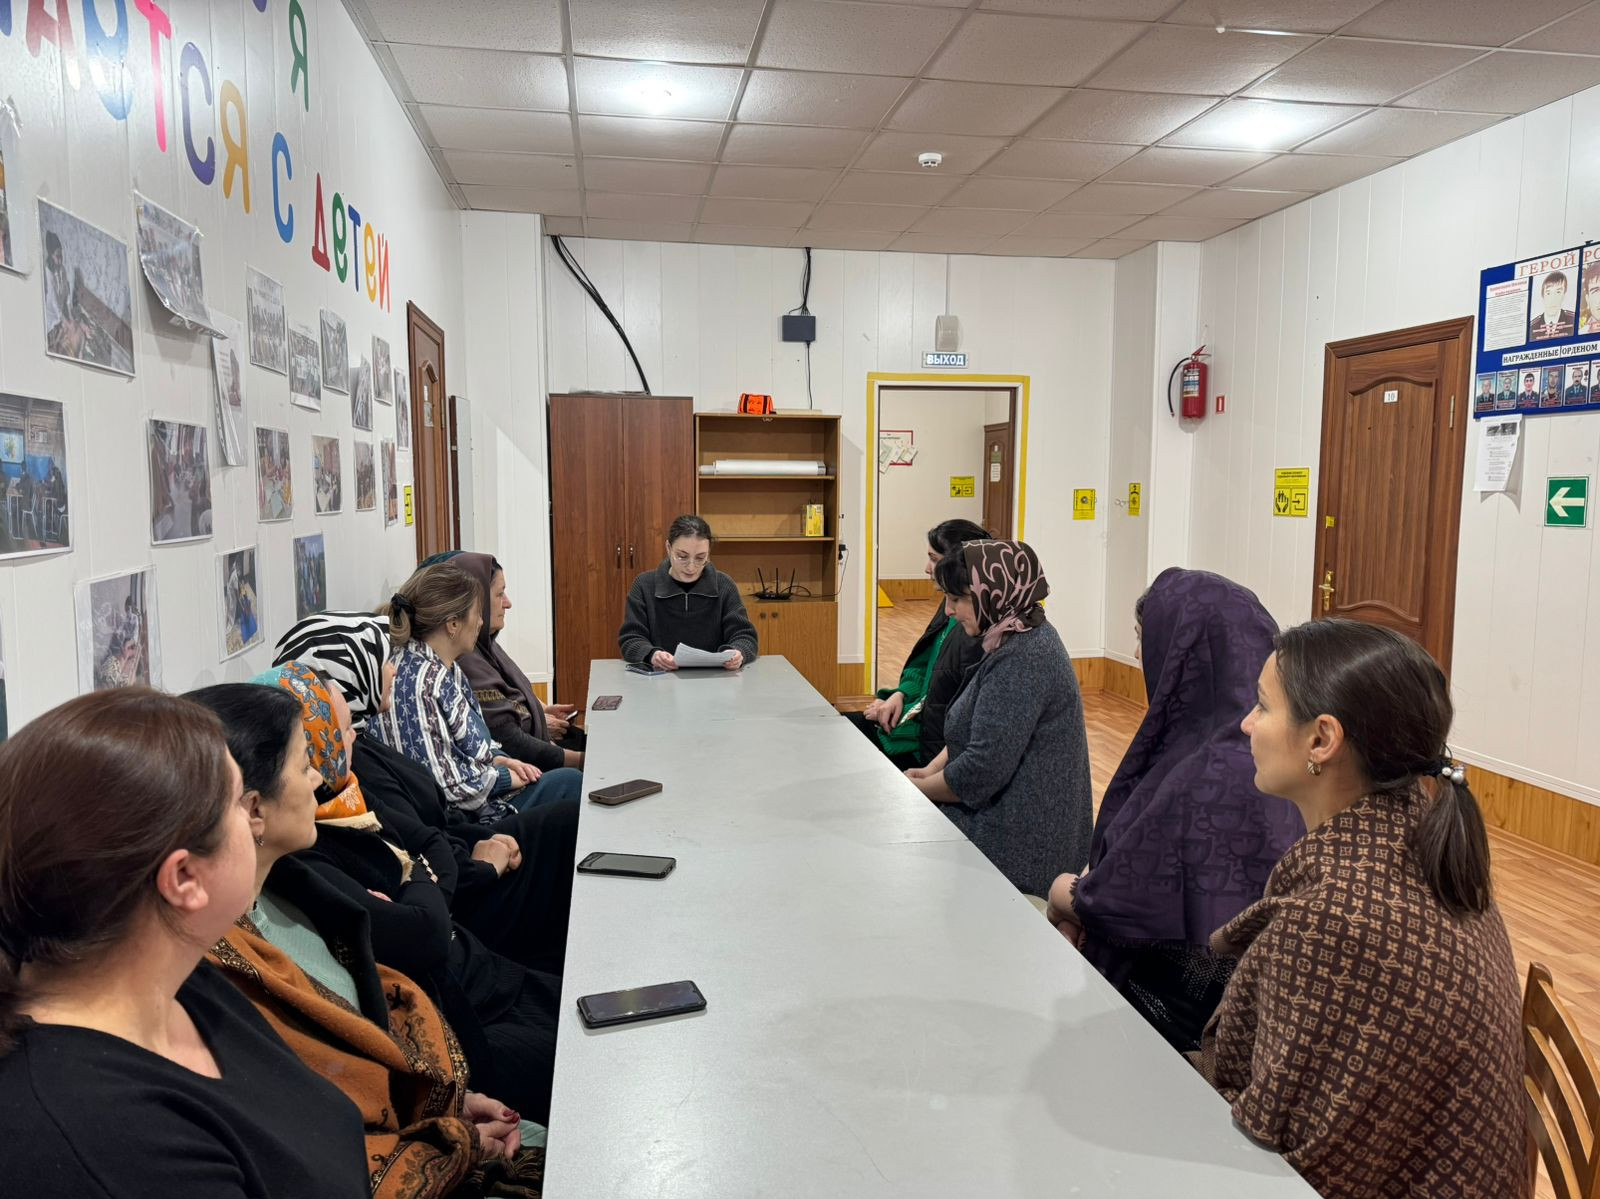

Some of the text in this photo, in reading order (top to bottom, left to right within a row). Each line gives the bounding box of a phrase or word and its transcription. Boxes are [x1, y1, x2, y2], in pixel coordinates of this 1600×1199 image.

[1519, 252, 1576, 276] ГЕРОЙ
[927, 354, 964, 365] ВЫХОД
[1503, 343, 1598, 363] НАГРАЖДЕННЫЕ ОРДЕНОМ
